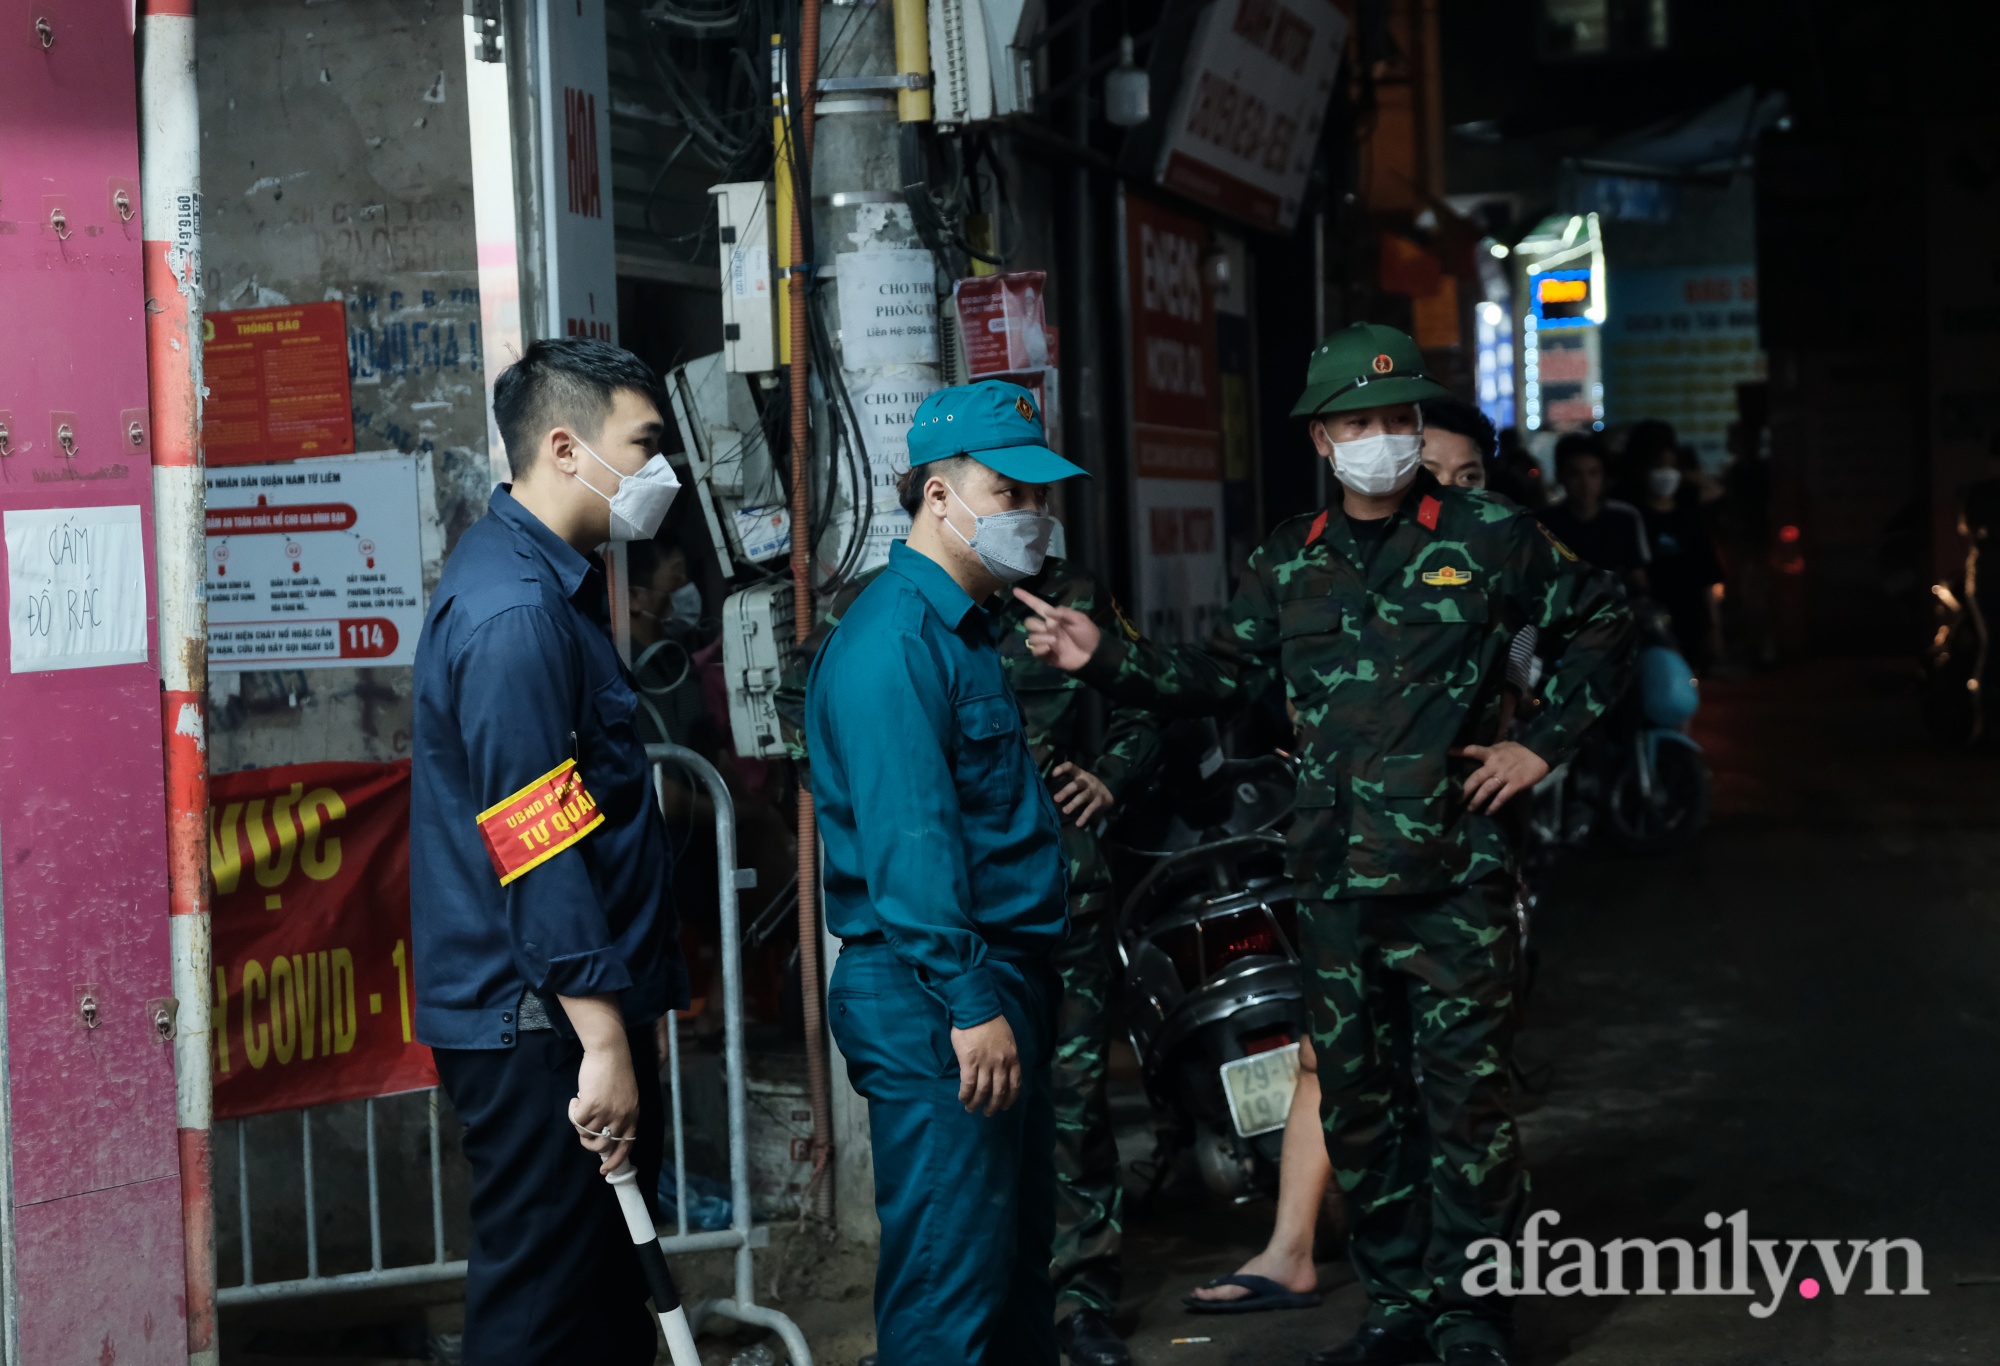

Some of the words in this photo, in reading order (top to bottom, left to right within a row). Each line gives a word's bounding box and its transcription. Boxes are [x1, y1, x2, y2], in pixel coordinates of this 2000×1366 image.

[879, 282, 909, 295] CHO
[876, 301, 923, 317] PHÒNG
[237, 320, 274, 336] THÔNG
[277, 317, 300, 332] BÁO
[867, 326, 887, 337] Liên
[864, 392, 898, 405] CHO
[874, 414, 879, 425] 1
[216, 475, 239, 489] NHÂN
[241, 475, 258, 488] DÂN
[261, 474, 284, 488] QUẬN
[286, 474, 305, 485] NAM
[320, 472, 341, 484] LIÊM
[234, 514, 252, 528] TOÀN
[285, 514, 298, 526] CHO
[300, 513, 312, 525] GIA
[49, 516, 90, 566] CẤM
[28, 579, 52, 637] ĐỔ
[67, 573, 102, 632] RÁC
[213, 630, 233, 641] PHÁT
[235, 629, 253, 641] HIỆN
[255, 628, 276, 639] CHÁY
[278, 627, 289, 638] NỔ
[291, 627, 313, 639] HOẶC
[315, 626, 332, 637] CẦN
[347, 624, 385, 649] 114
[301, 641, 322, 651] NGAY
[324, 638, 335, 650] SỐ
[506, 800, 545, 829] UBND
[518, 819, 551, 851] TỰ
[243, 947, 357, 1070] COVID
[392, 939, 412, 1043] 1
